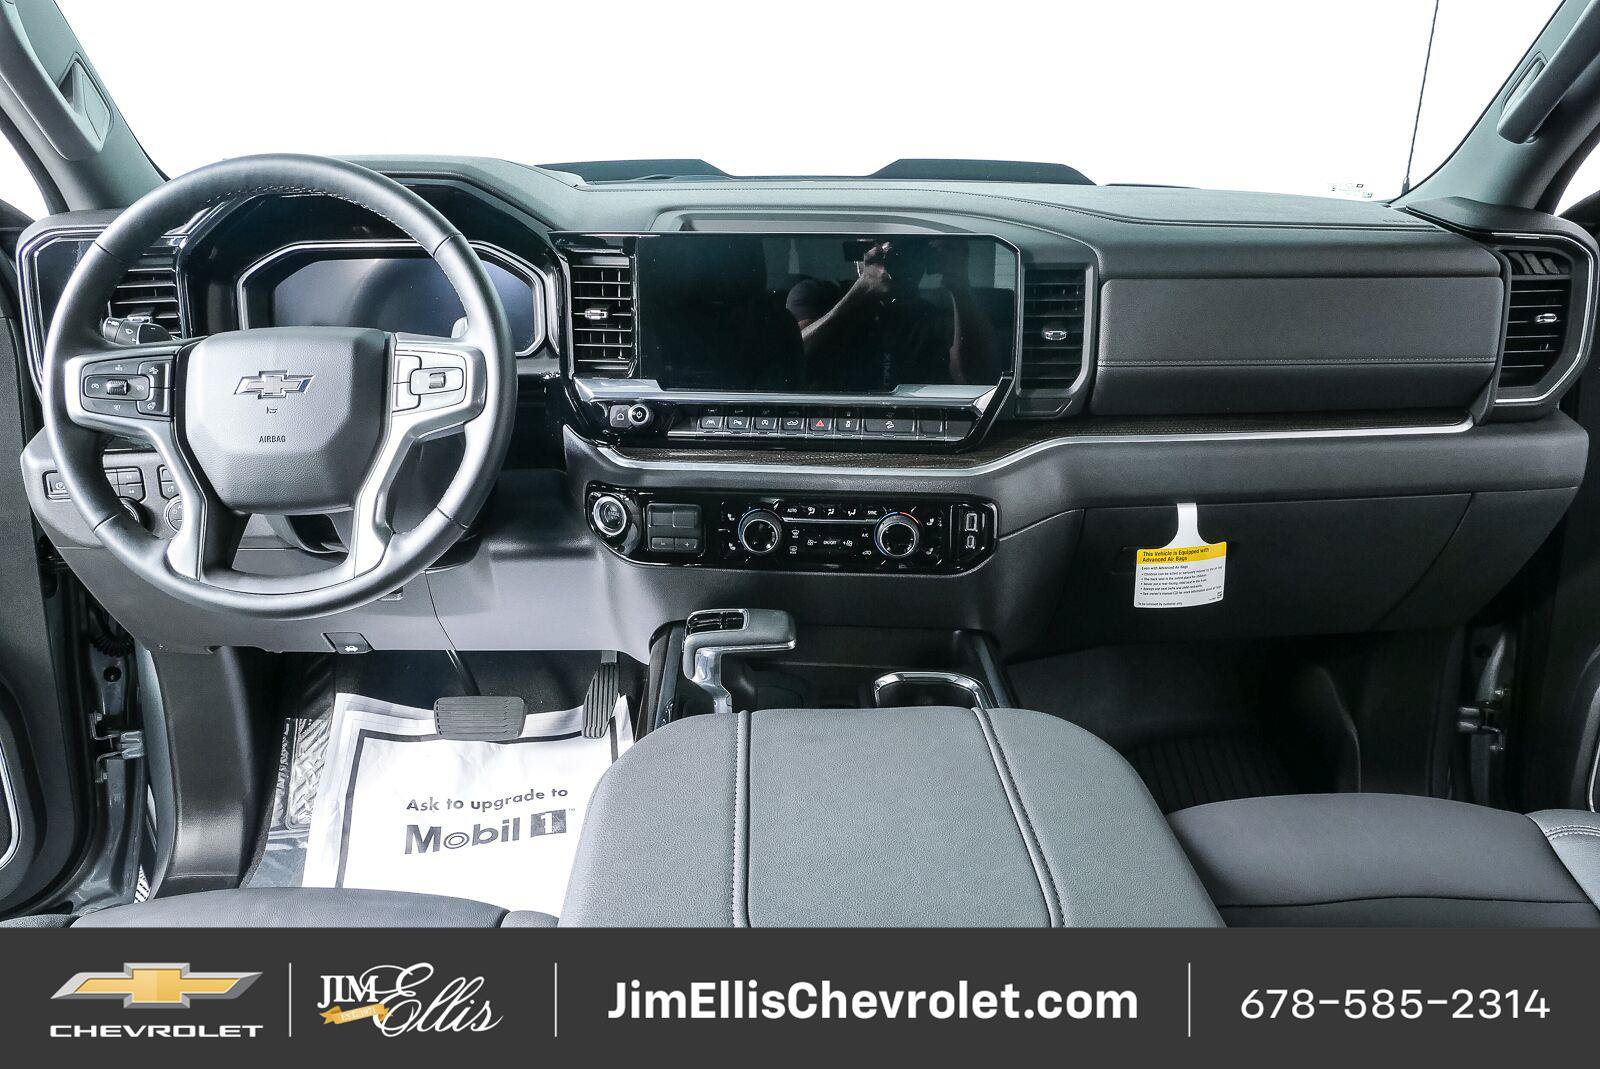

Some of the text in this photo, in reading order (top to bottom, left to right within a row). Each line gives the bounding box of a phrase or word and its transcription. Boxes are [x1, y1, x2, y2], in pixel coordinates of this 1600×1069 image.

[259, 435, 286, 443] AIRBAG
[1179, 548, 1200, 556] Equipped
[406, 788, 568, 812] Ask to upgrade to
[404, 817, 520, 855] Mobil
